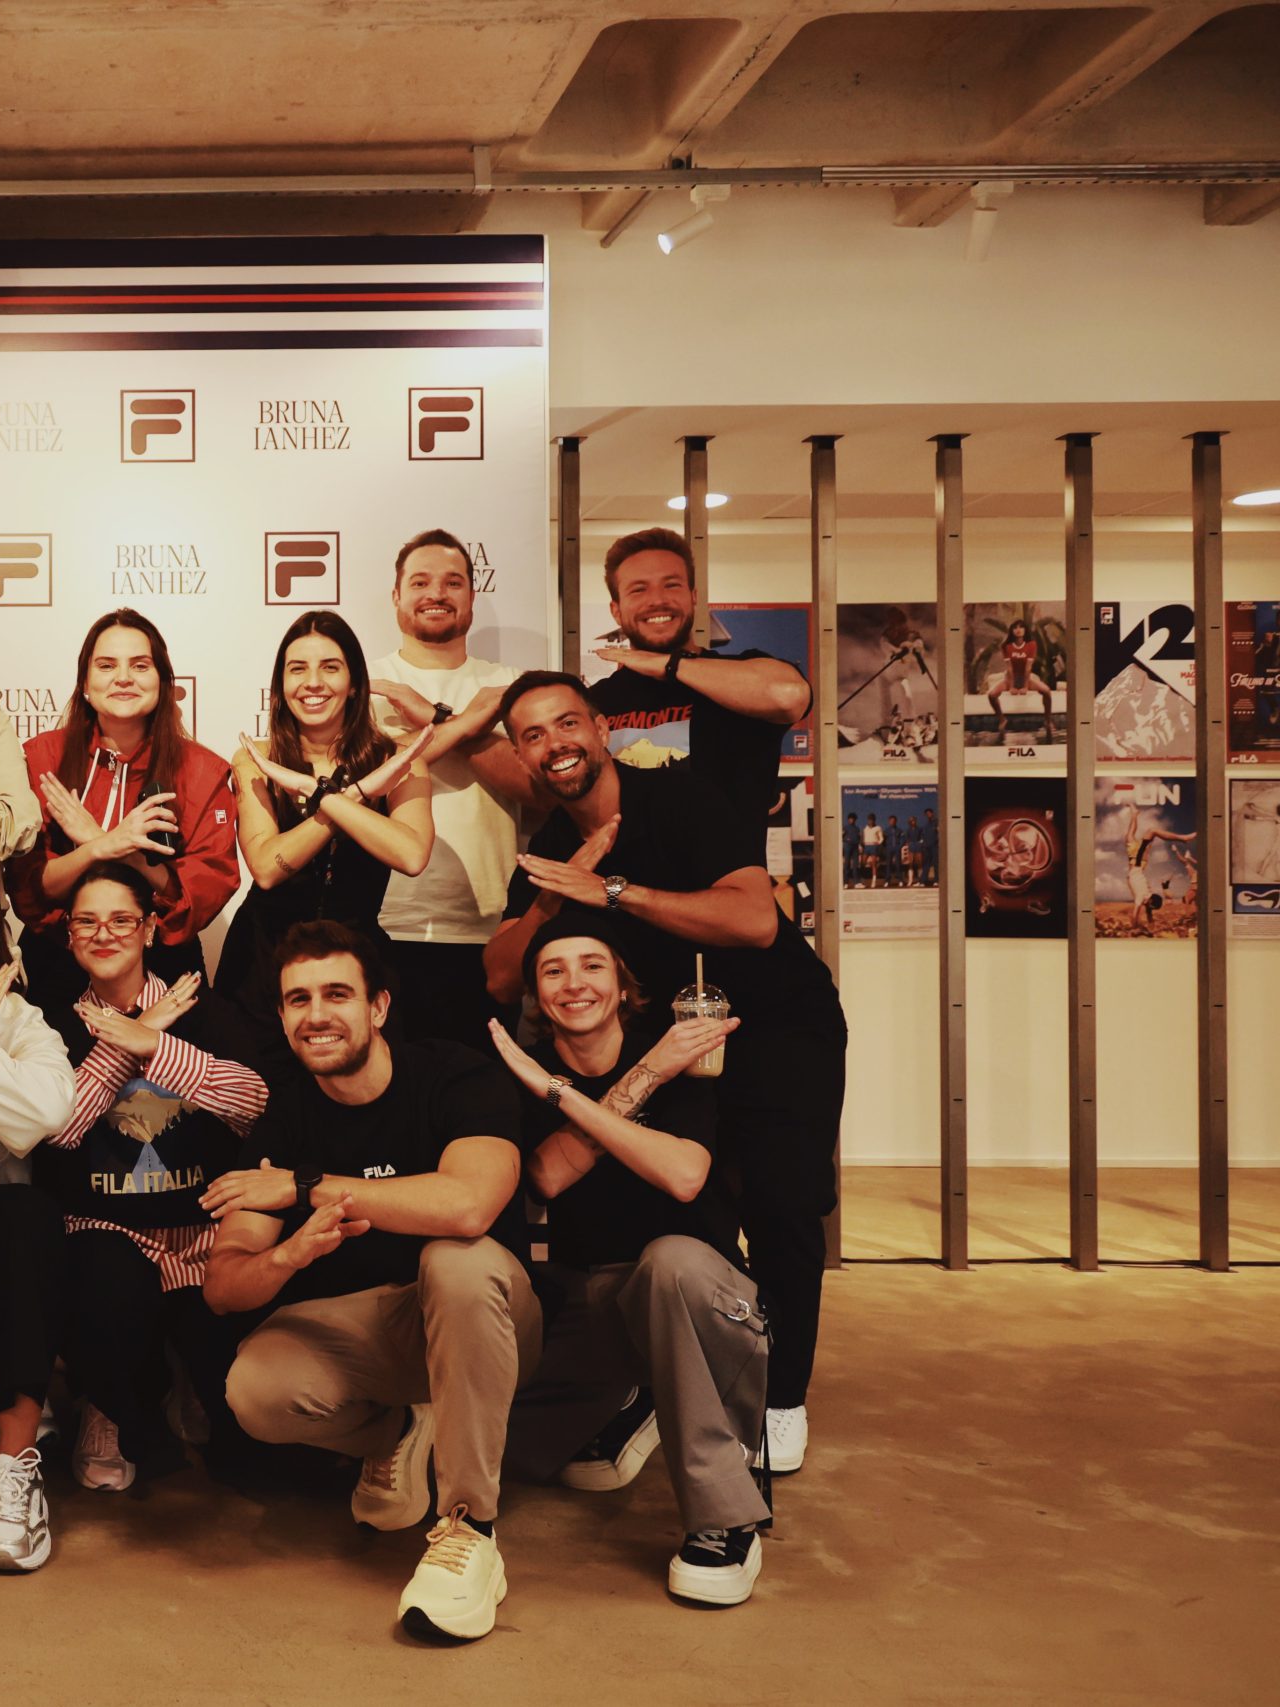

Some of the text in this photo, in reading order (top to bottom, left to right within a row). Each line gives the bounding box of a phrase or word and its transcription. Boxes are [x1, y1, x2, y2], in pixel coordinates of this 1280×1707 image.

[260, 401, 343, 423] BRUNA
[255, 427, 350, 450] IANHEZ
[117, 545, 200, 568] BRUNA
[112, 571, 206, 594] IANHEZ
[1095, 603, 1195, 696] K2
[607, 704, 693, 731] PIEMONTE
[883, 749, 907, 757] FILA
[1008, 747, 1036, 757] FILA
[1113, 783, 1180, 805] FUN
[91, 1164, 205, 1195] FILA ITALIA
[363, 1163, 396, 1179] FILA
